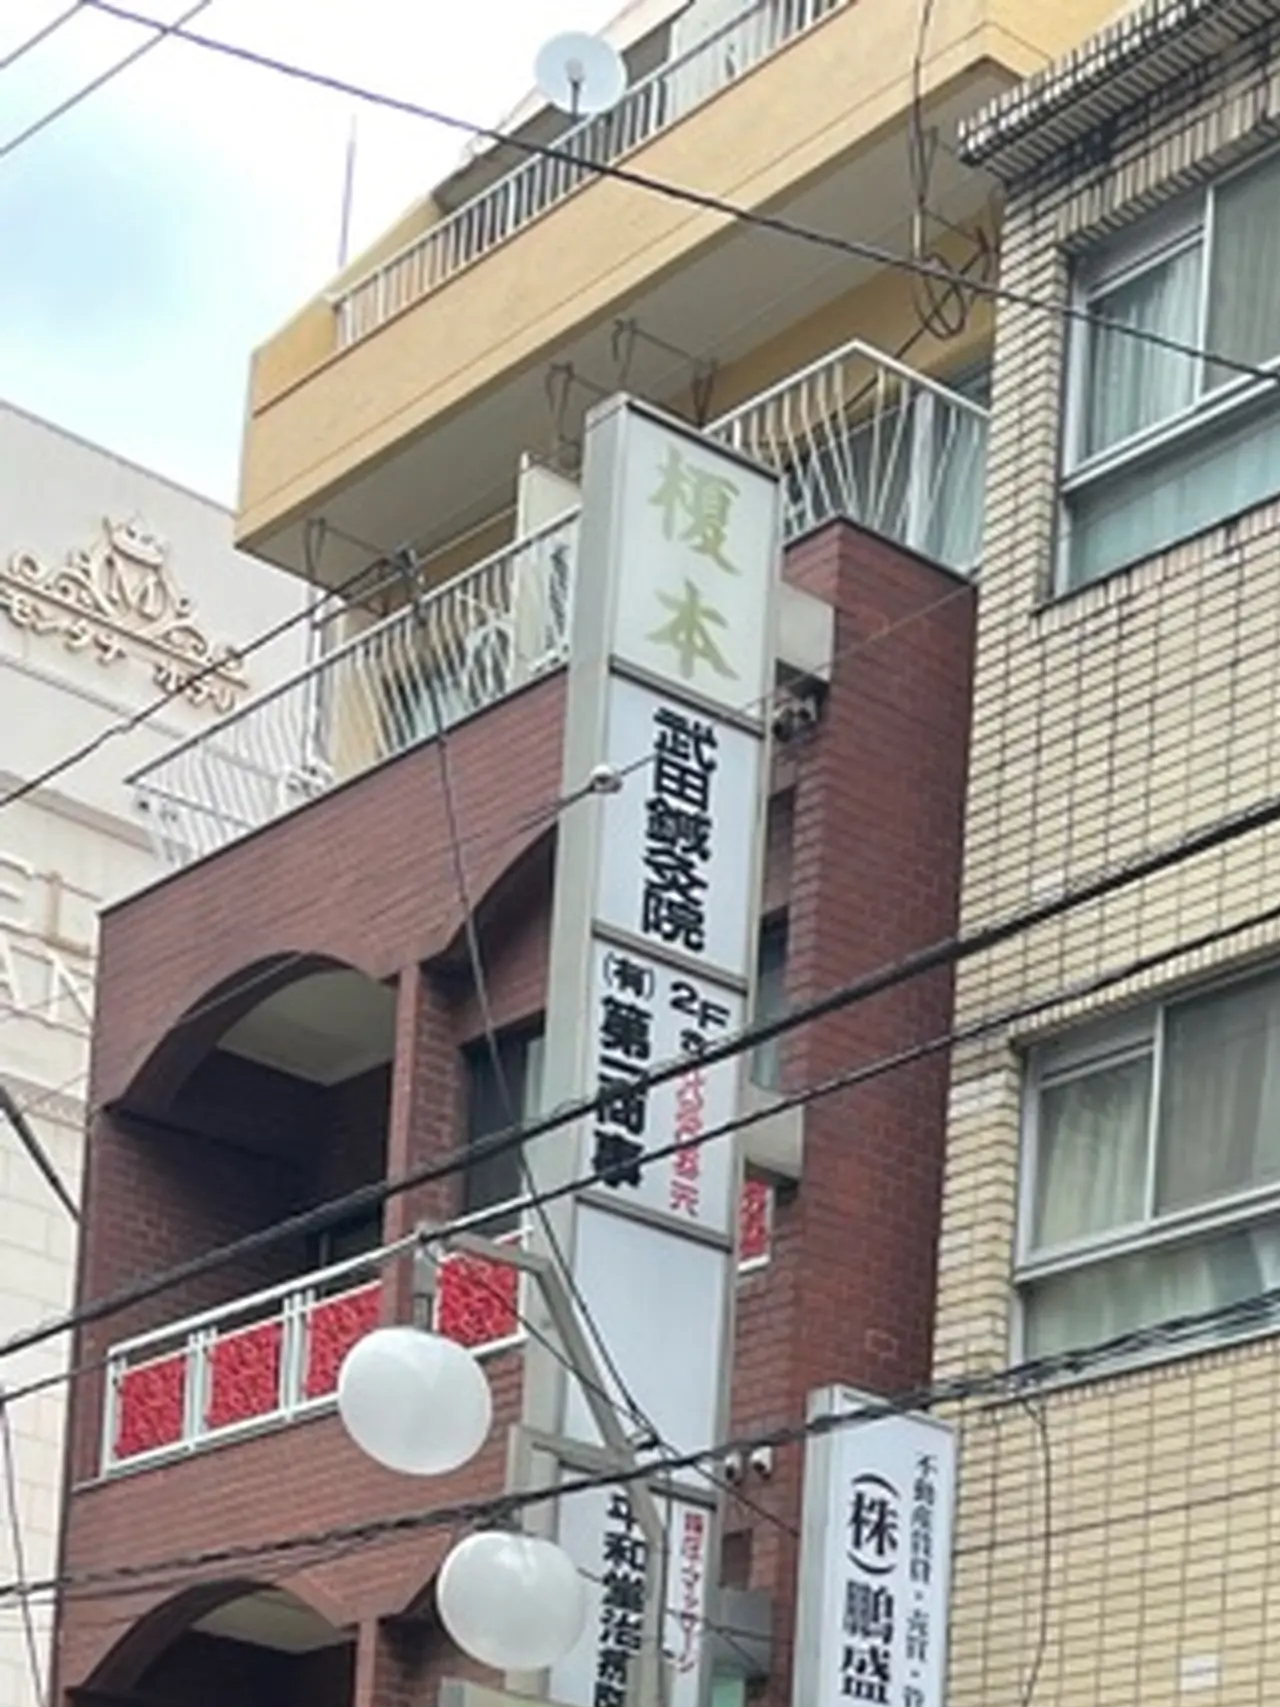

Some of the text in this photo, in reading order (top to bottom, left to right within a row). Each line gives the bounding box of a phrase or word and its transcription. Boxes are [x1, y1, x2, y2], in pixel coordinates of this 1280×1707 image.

[645, 442, 743, 681] 榎本
[670, 980, 731, 1029] 2F
[839, 1472, 902, 1706] (株)鵬盛
